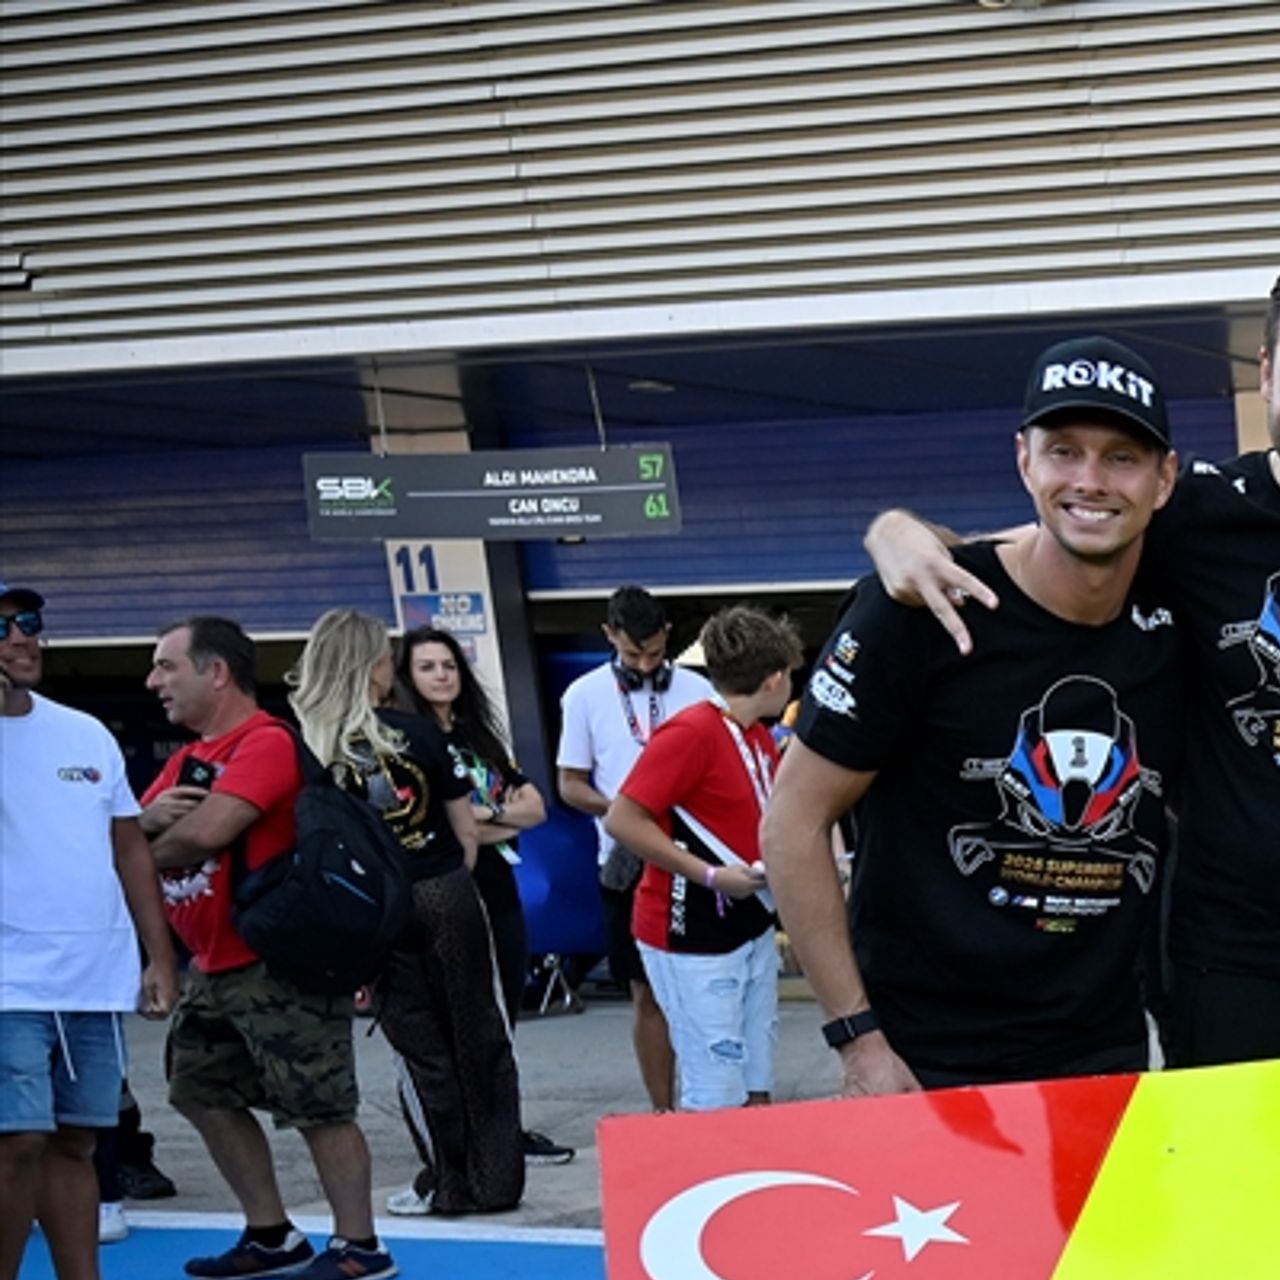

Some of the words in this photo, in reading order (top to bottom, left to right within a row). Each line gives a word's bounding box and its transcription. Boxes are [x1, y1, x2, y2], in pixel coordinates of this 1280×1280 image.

[483, 470, 517, 487] ALDI
[521, 466, 597, 486] MAHENDRA
[639, 454, 665, 481] 57
[508, 499, 538, 515] CAN
[643, 492, 671, 518] 61
[394, 543, 440, 592] 11
[440, 594, 471, 613] NO
